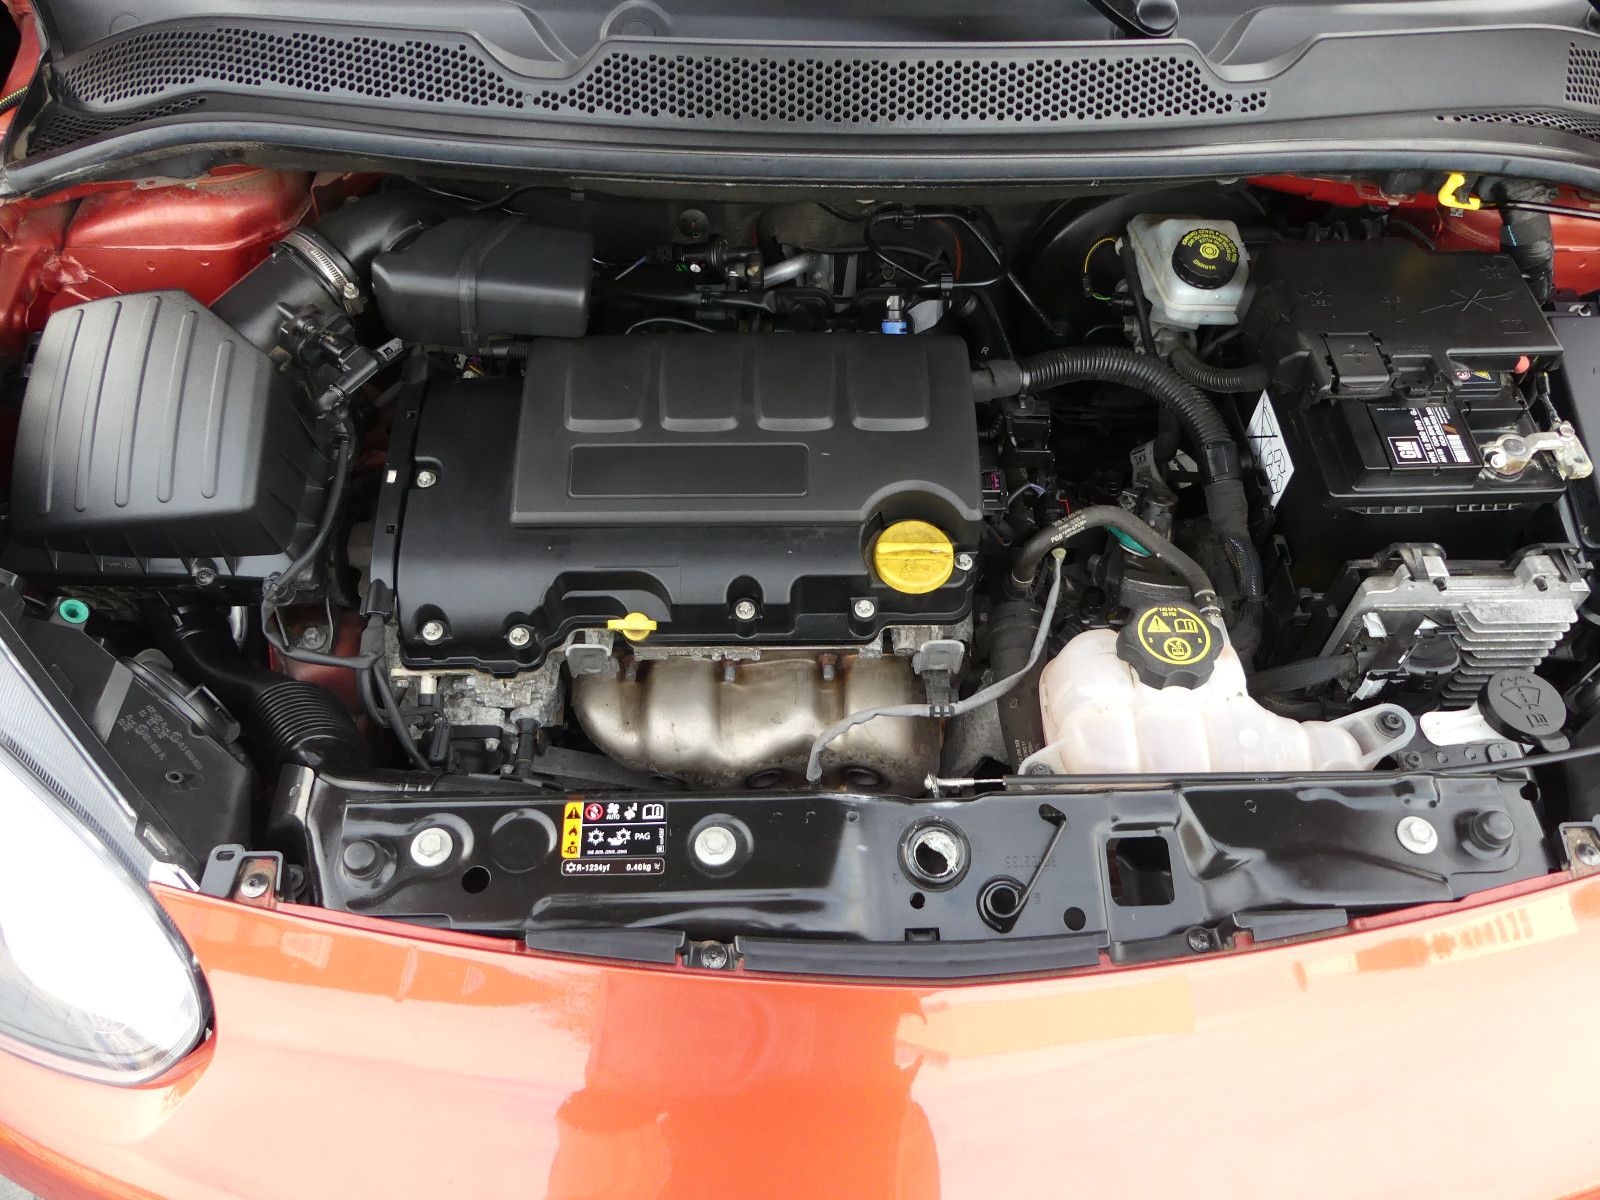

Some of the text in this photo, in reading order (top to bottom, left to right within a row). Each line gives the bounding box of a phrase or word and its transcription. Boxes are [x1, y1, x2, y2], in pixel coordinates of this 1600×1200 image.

[1396, 441, 1417, 459] GM
[634, 832, 651, 840] PAG
[576, 863, 611, 873] R-1234yf
